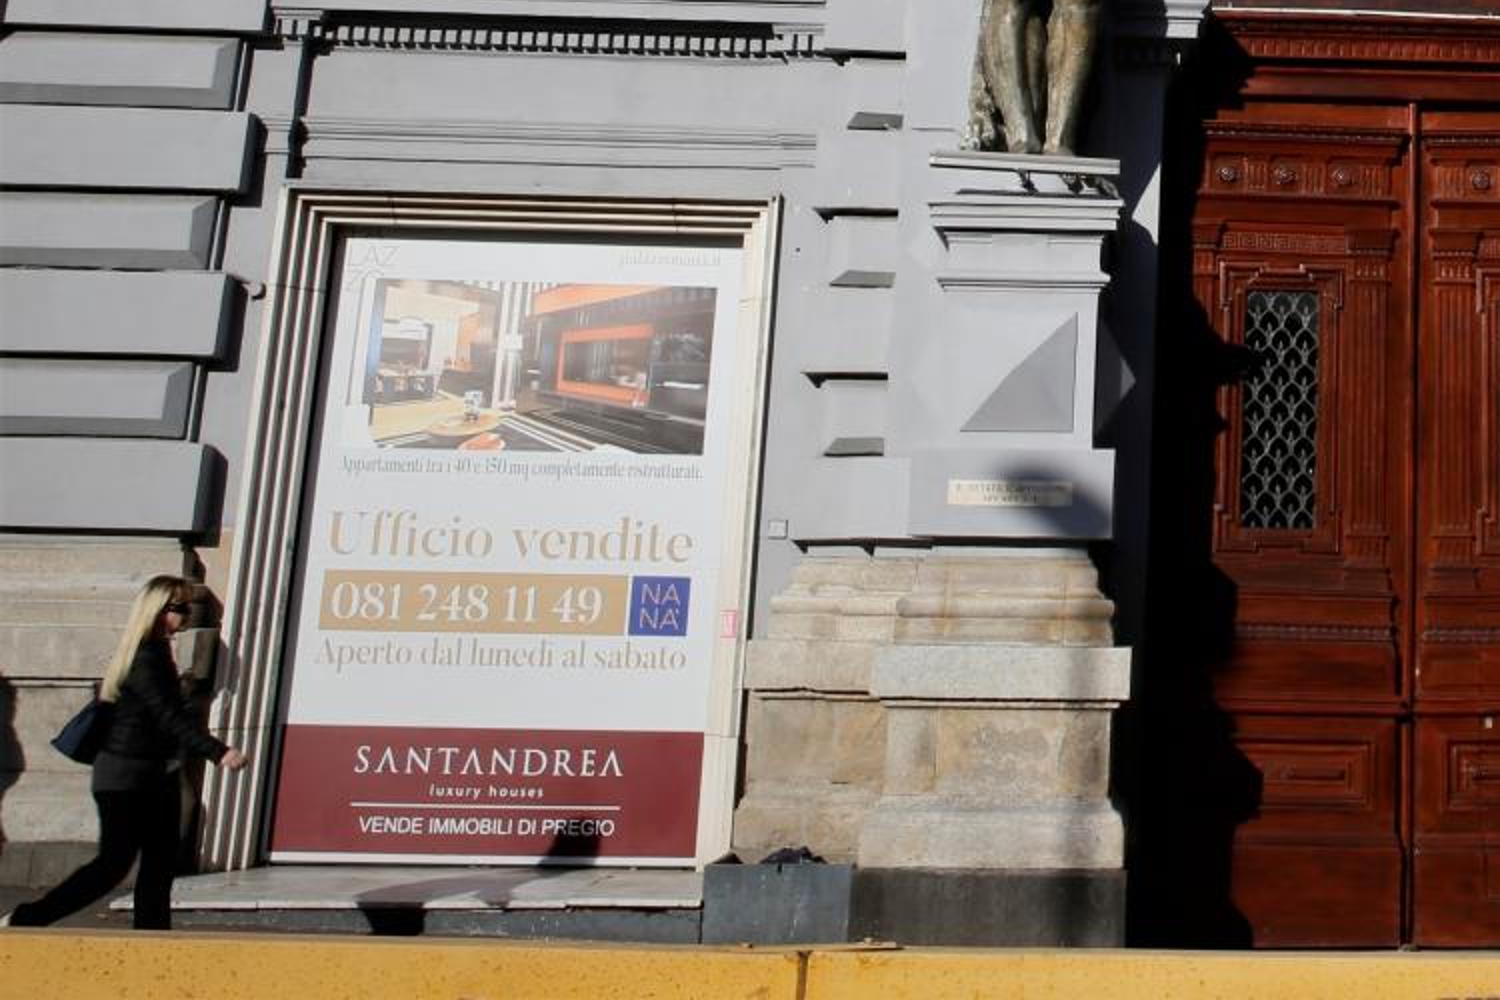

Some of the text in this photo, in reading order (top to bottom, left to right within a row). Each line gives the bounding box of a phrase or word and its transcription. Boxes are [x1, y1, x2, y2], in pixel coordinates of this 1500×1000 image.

[329, 510, 694, 563] Ufficio vendite
[330, 580, 603, 624] 081 248 11 49
[640, 583, 681, 605] NA
[316, 637, 413, 674] Aperto
[421, 637, 462, 666] dal
[561, 639, 587, 668] al
[593, 640, 687, 672] sabato
[353, 744, 624, 778] SANTANDREA
[429, 783, 545, 801] luxury houses
[359, 815, 616, 838] VENDE IMMOBILI DI PREGIO
